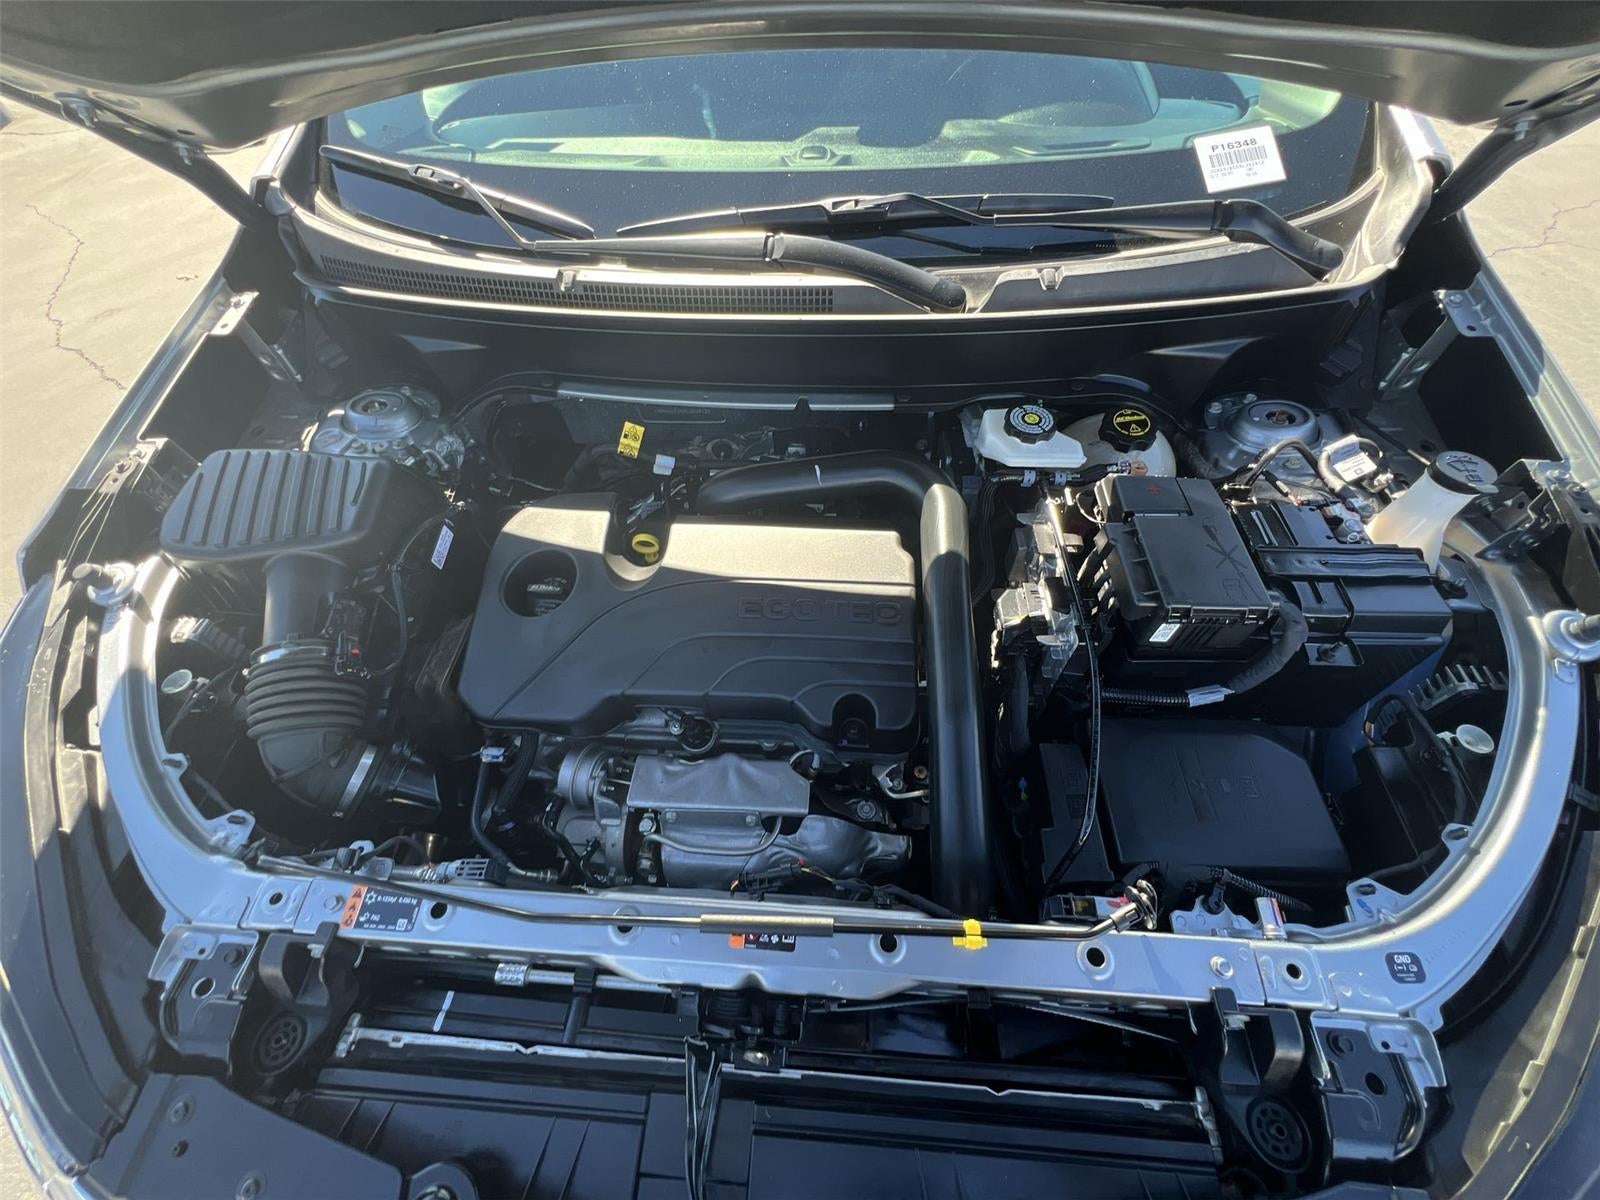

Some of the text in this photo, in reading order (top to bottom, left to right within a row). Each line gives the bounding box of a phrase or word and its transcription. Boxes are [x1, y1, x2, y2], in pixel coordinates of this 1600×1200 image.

[1211, 138, 1257, 152] P16348
[738, 598, 901, 626] ECOTEC
[1394, 954, 1411, 963] GND
